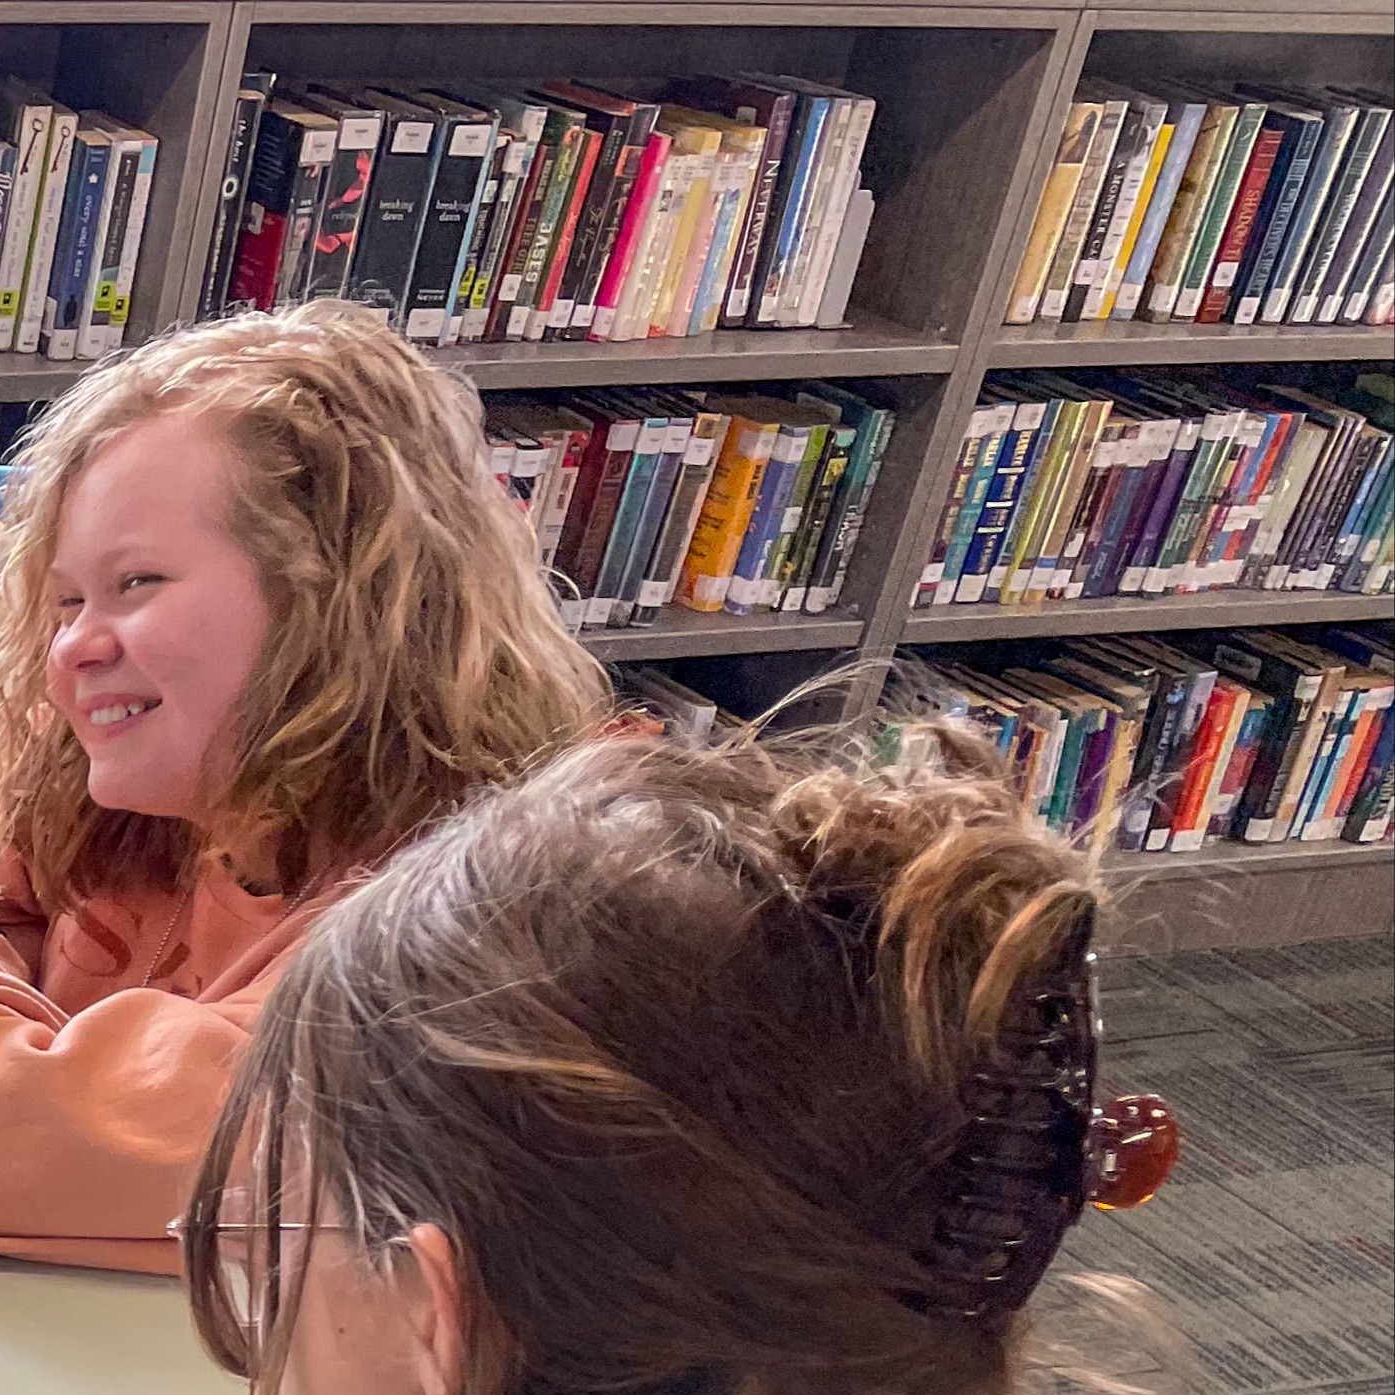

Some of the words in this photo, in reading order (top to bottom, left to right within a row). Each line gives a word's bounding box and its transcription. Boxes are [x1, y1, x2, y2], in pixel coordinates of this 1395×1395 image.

[80, 195, 93, 223] every
[379, 200, 415, 213] breaking
[435, 200, 469, 213] breaking
[1097, 174, 1123, 233] MONSTER
[1235, 189, 1260, 244] SHADOW
[522, 217, 536, 245] TREE
[73, 259, 83, 278] star
